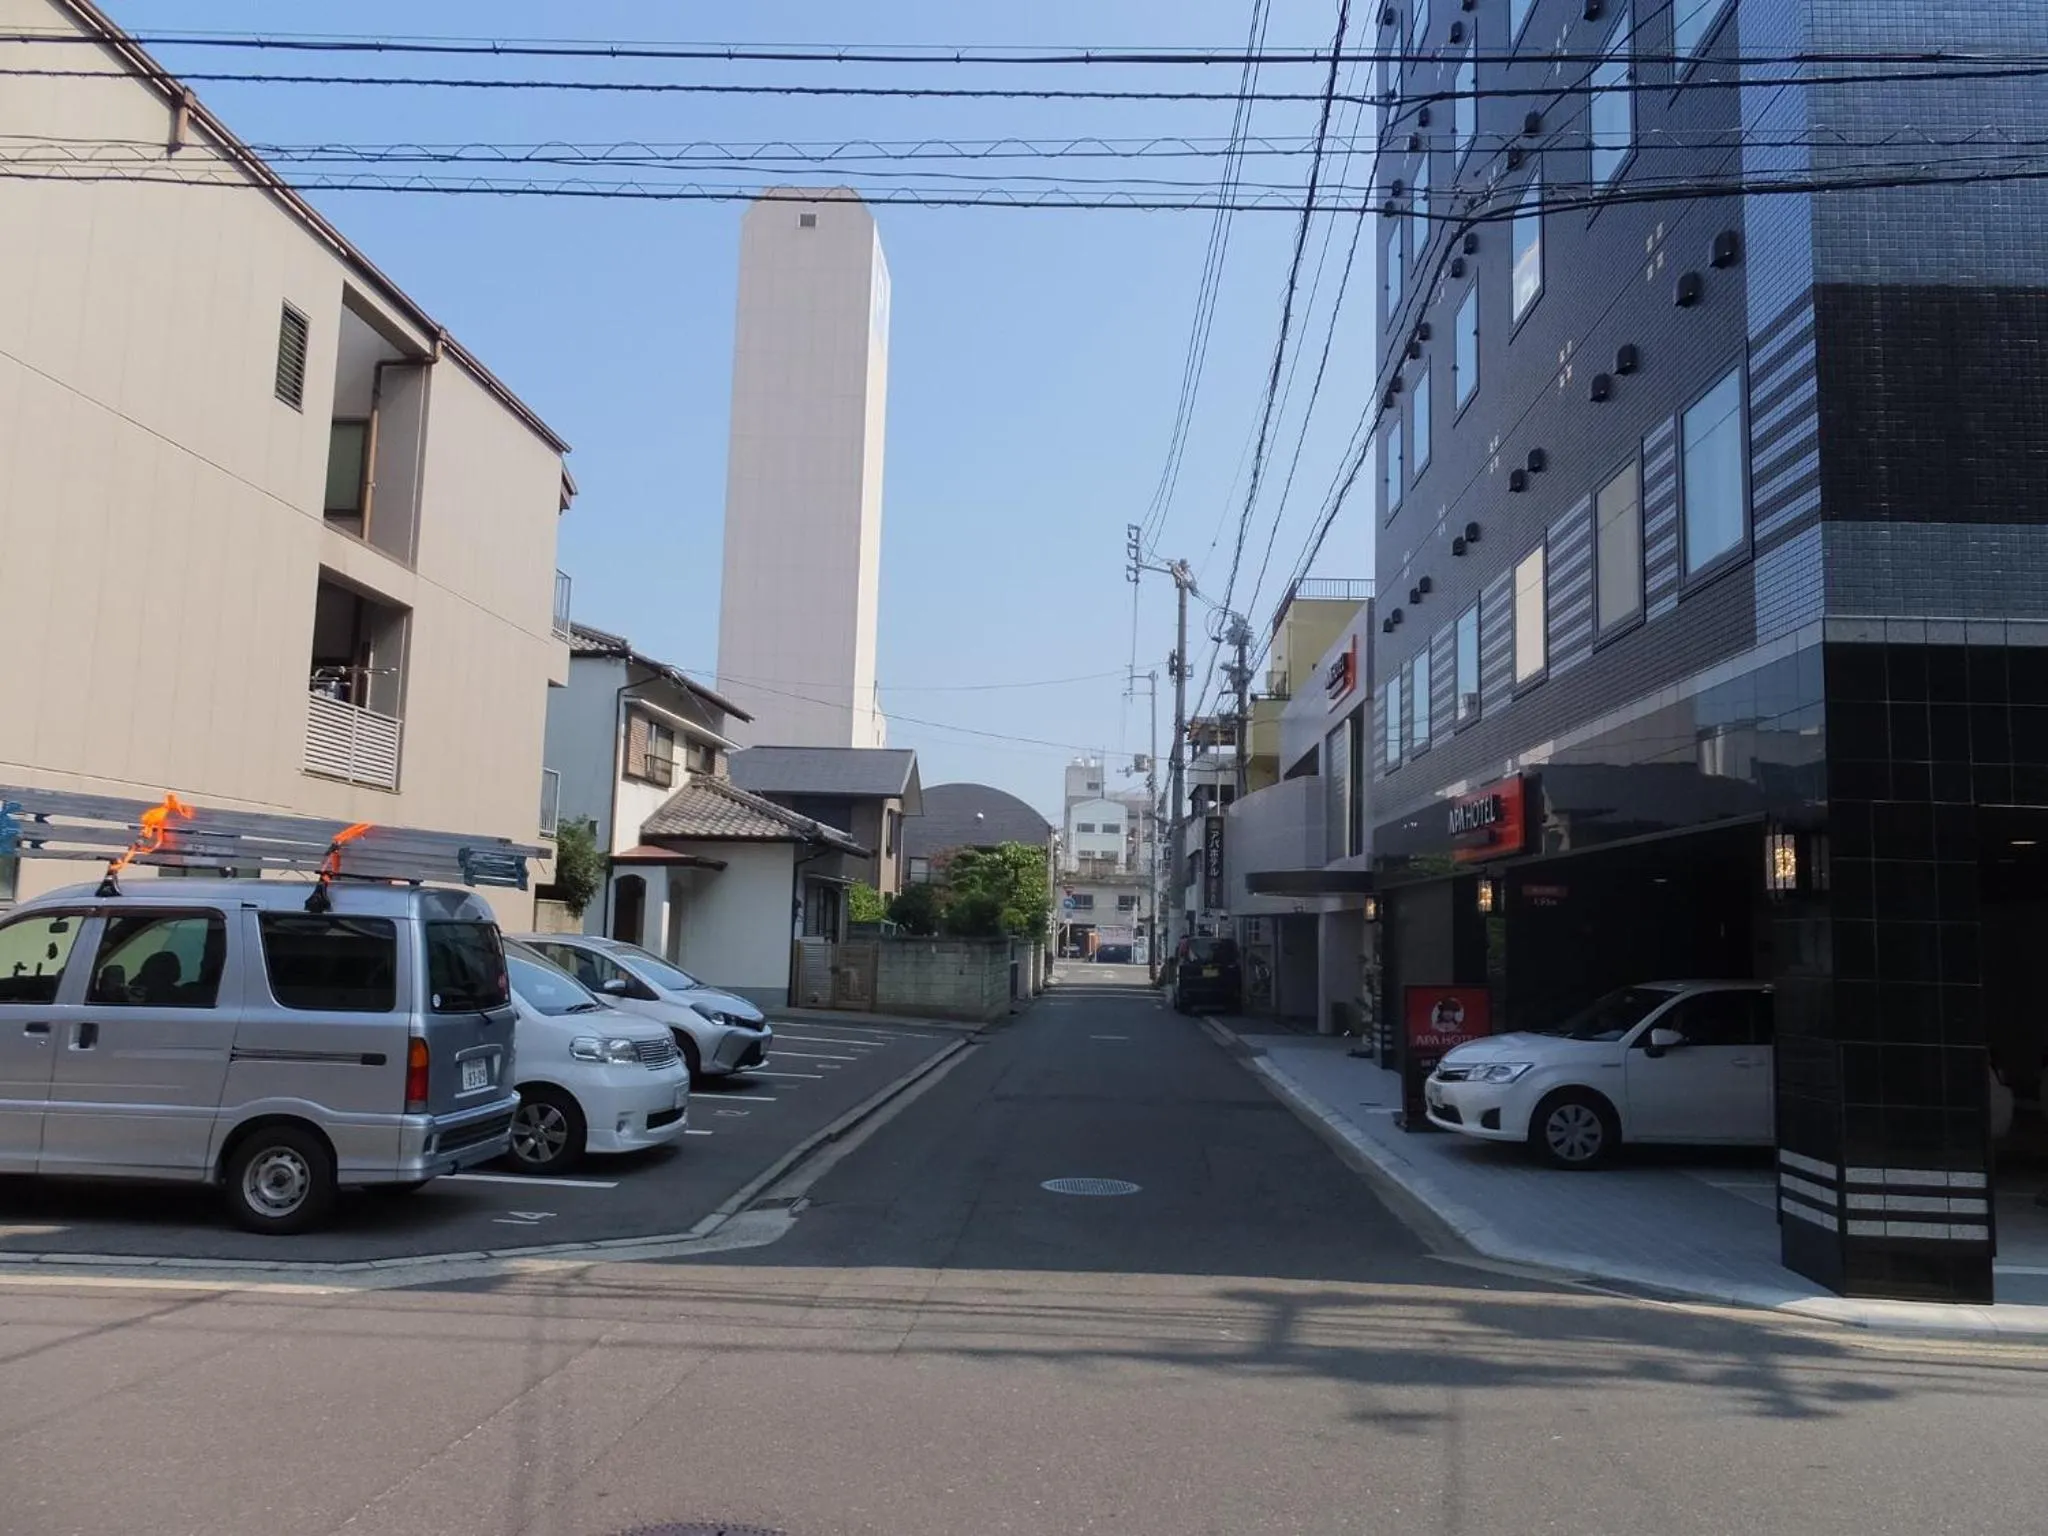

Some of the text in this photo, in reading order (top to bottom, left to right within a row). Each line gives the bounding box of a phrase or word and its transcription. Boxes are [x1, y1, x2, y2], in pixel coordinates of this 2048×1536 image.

[1448, 791, 1495, 832] APA HOTEL
[1209, 829, 1220, 877] アパホテル
[1416, 1034, 1439, 1045] APA
[491, 1211, 557, 1224] 14
